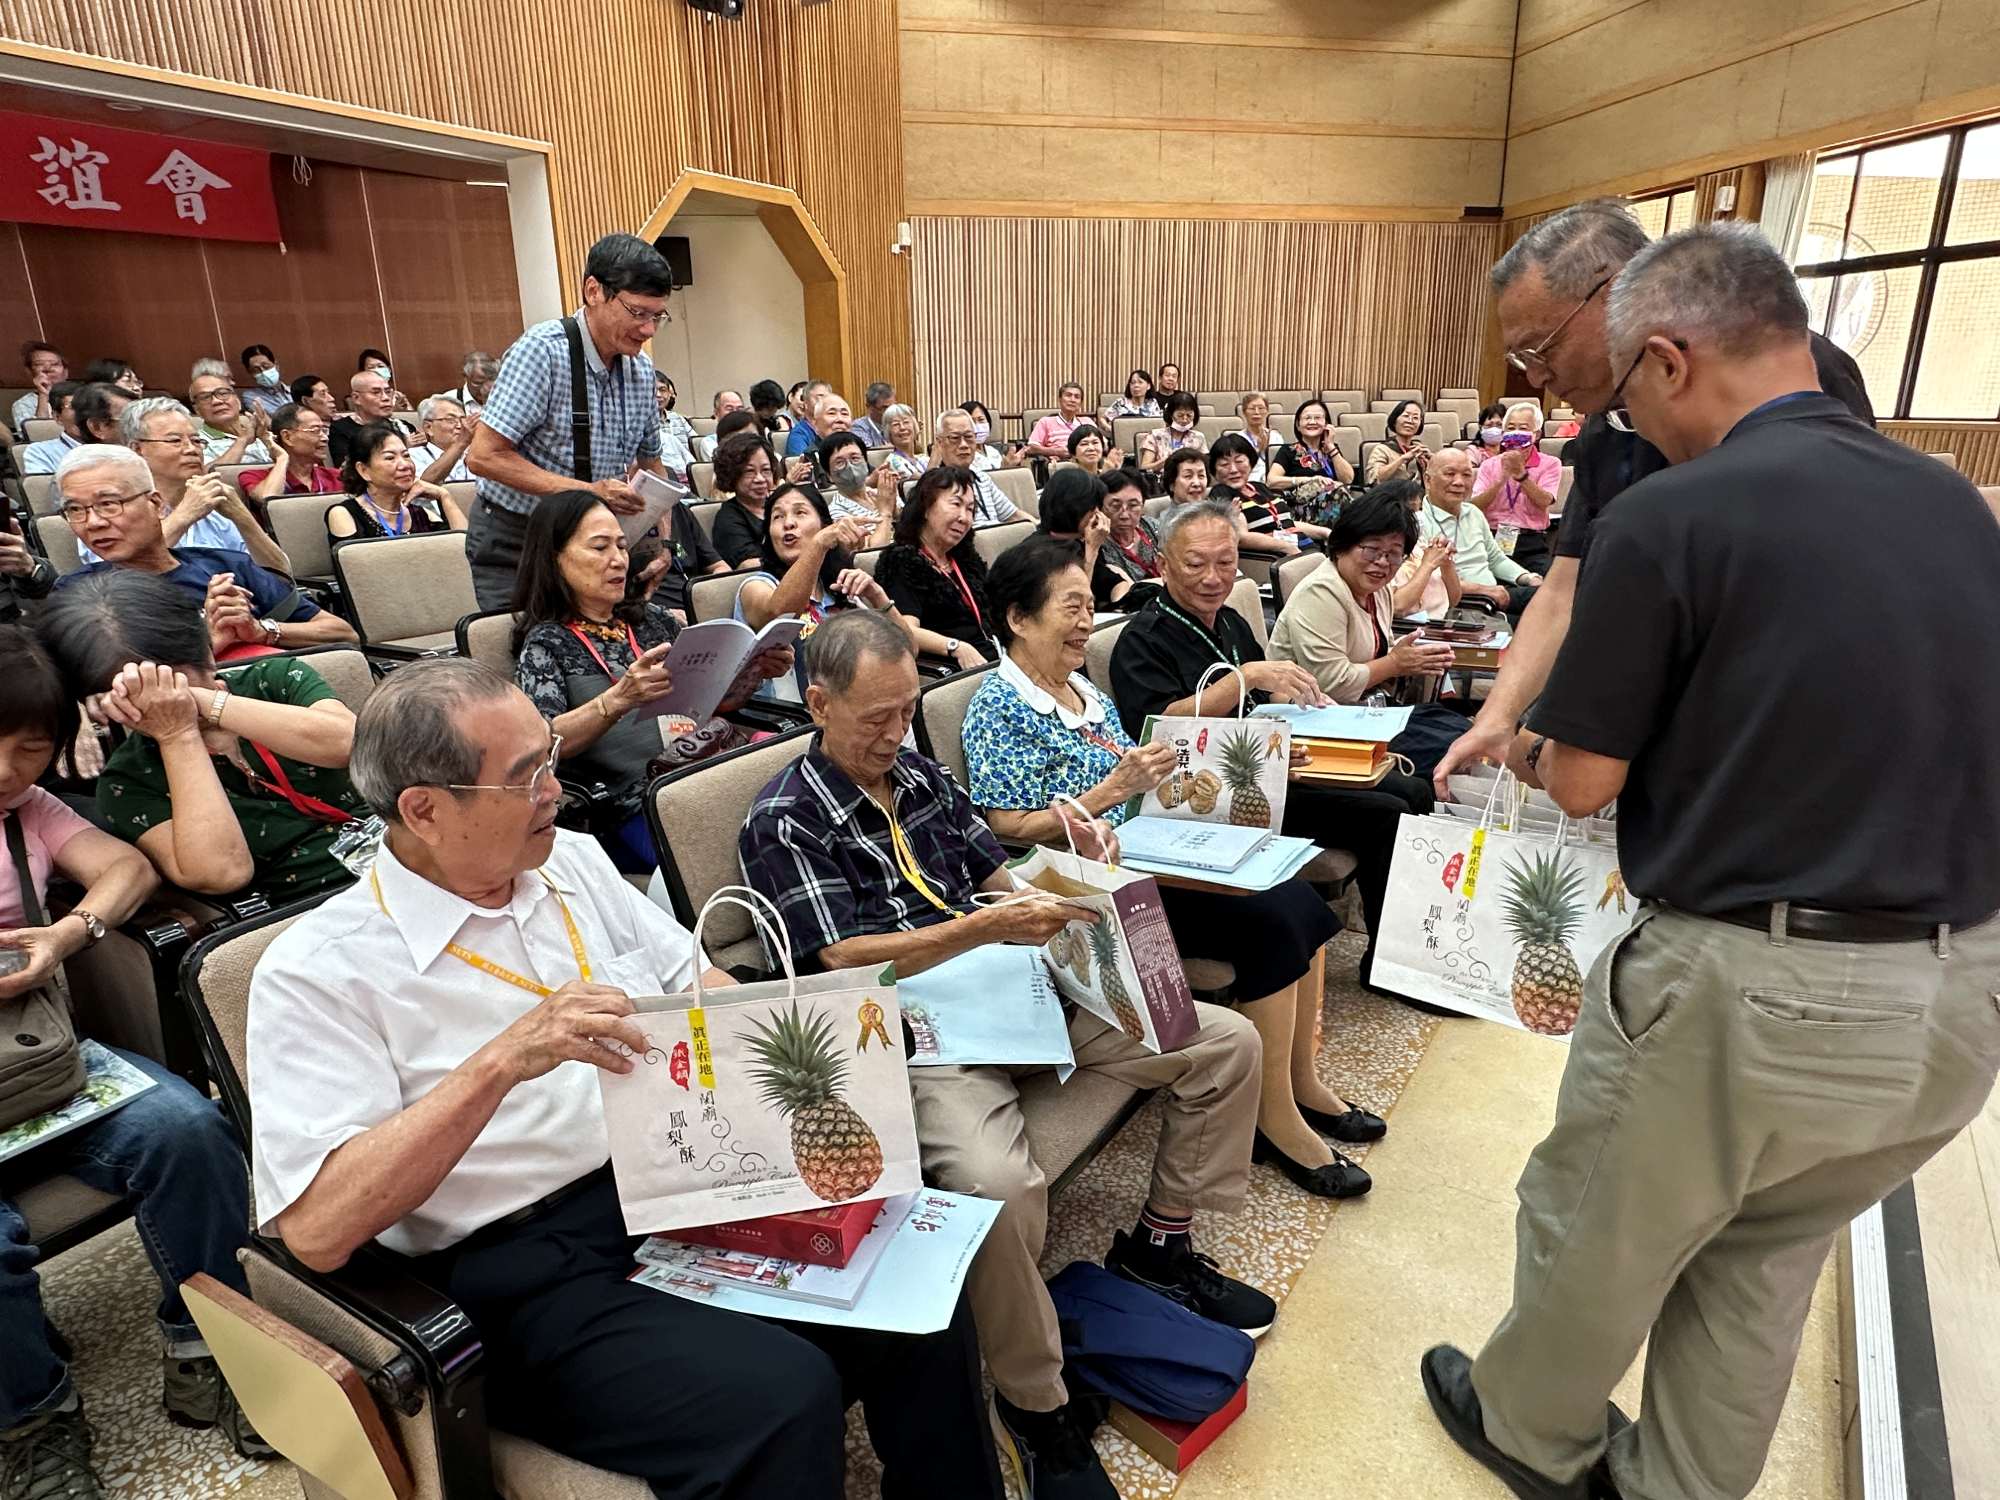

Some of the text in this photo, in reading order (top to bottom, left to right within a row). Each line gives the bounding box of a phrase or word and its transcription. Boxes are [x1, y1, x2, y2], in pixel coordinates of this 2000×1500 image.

[30, 136, 232, 224] 誼會
[666, 1110, 696, 1164] 鳳梨酥
